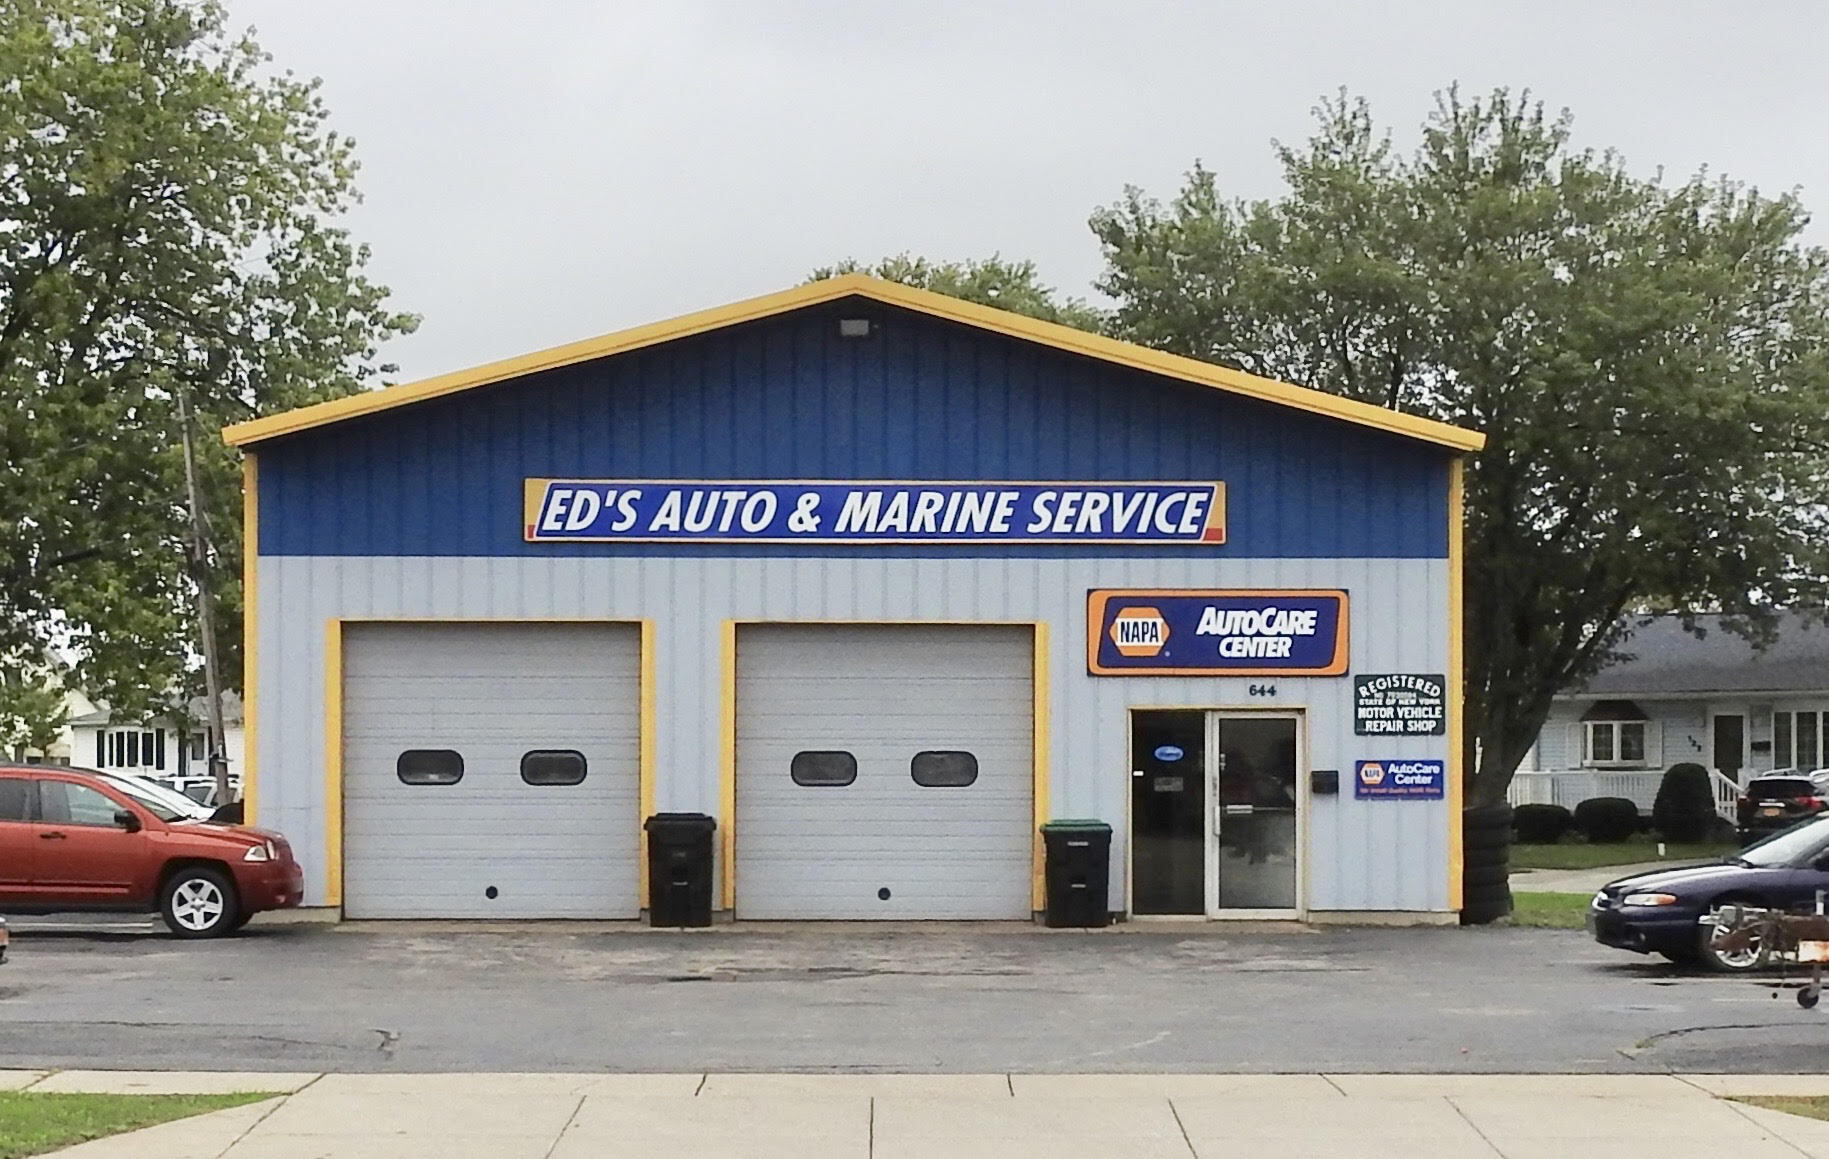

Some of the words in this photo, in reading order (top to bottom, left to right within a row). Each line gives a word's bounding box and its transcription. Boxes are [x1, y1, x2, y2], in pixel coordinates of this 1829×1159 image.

[541, 489, 642, 532] ED'S
[649, 490, 777, 533] AUTO
[787, 492, 821, 534] &
[834, 491, 1020, 533] MARINE
[1026, 491, 1209, 534] SERVICE
[1120, 621, 1159, 643] NAPA
[1219, 636, 1293, 658] CENTER
[1249, 684, 1277, 696] 644
[1358, 675, 1441, 697] REGISTERED
[1359, 698, 1383, 706] STATE
[1385, 698, 1396, 706] OF
[1398, 698, 1417, 706] NEW
[1357, 706, 1395, 719] MOTOR
[1396, 706, 1442, 719] VEHICLE
[1365, 720, 1404, 732] REPAIR
[1406, 720, 1437, 732] SHOP
[1387, 763, 1441, 774] AutoCare
[1394, 774, 1433, 785] Center
